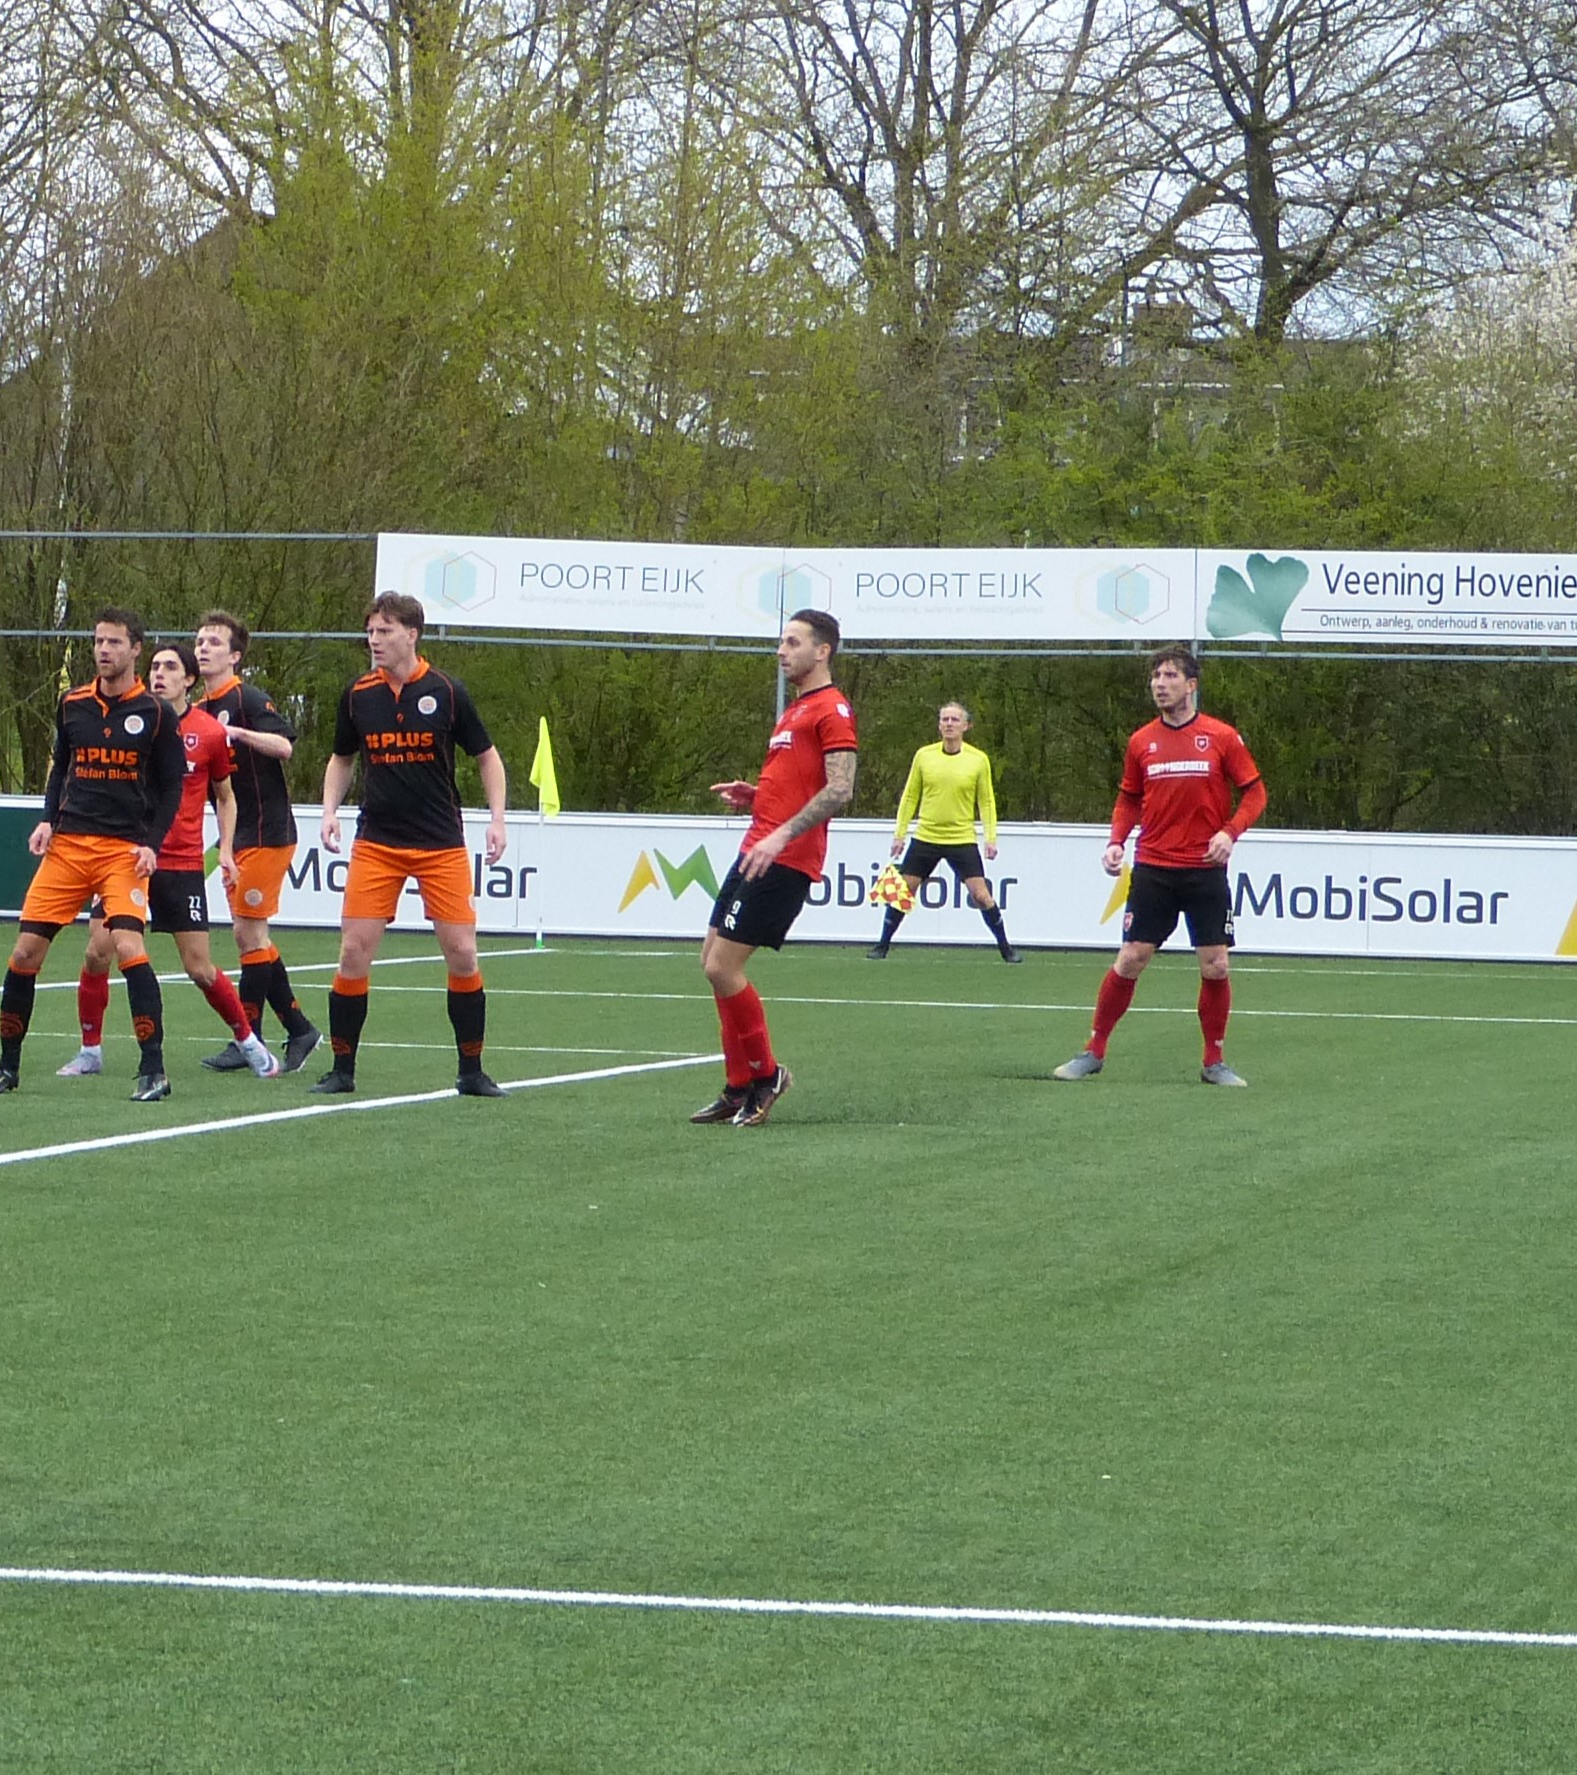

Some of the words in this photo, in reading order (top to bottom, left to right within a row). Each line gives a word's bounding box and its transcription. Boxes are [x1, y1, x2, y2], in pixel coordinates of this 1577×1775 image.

[1322, 563, 1444, 605] Veening
[1455, 565, 1577, 599] Hovenie
[1320, 614, 1372, 629] Ontwerp,
[1375, 615, 1413, 631] aanleg,
[1417, 615, 1477, 630] onderhoud
[1480, 617, 1488, 630] &
[1491, 617, 1544, 631] renovatie
[1547, 620, 1566, 631] van
[382, 731, 434, 749] PLUS
[87, 747, 138, 767] PLUS
[75, 766, 105, 780] Stefan
[108, 768, 138, 781] Blom
[287, 847, 538, 899] Molar
[808, 862, 1019, 910] obiolar
[1234, 872, 1510, 925] MobiSolar
